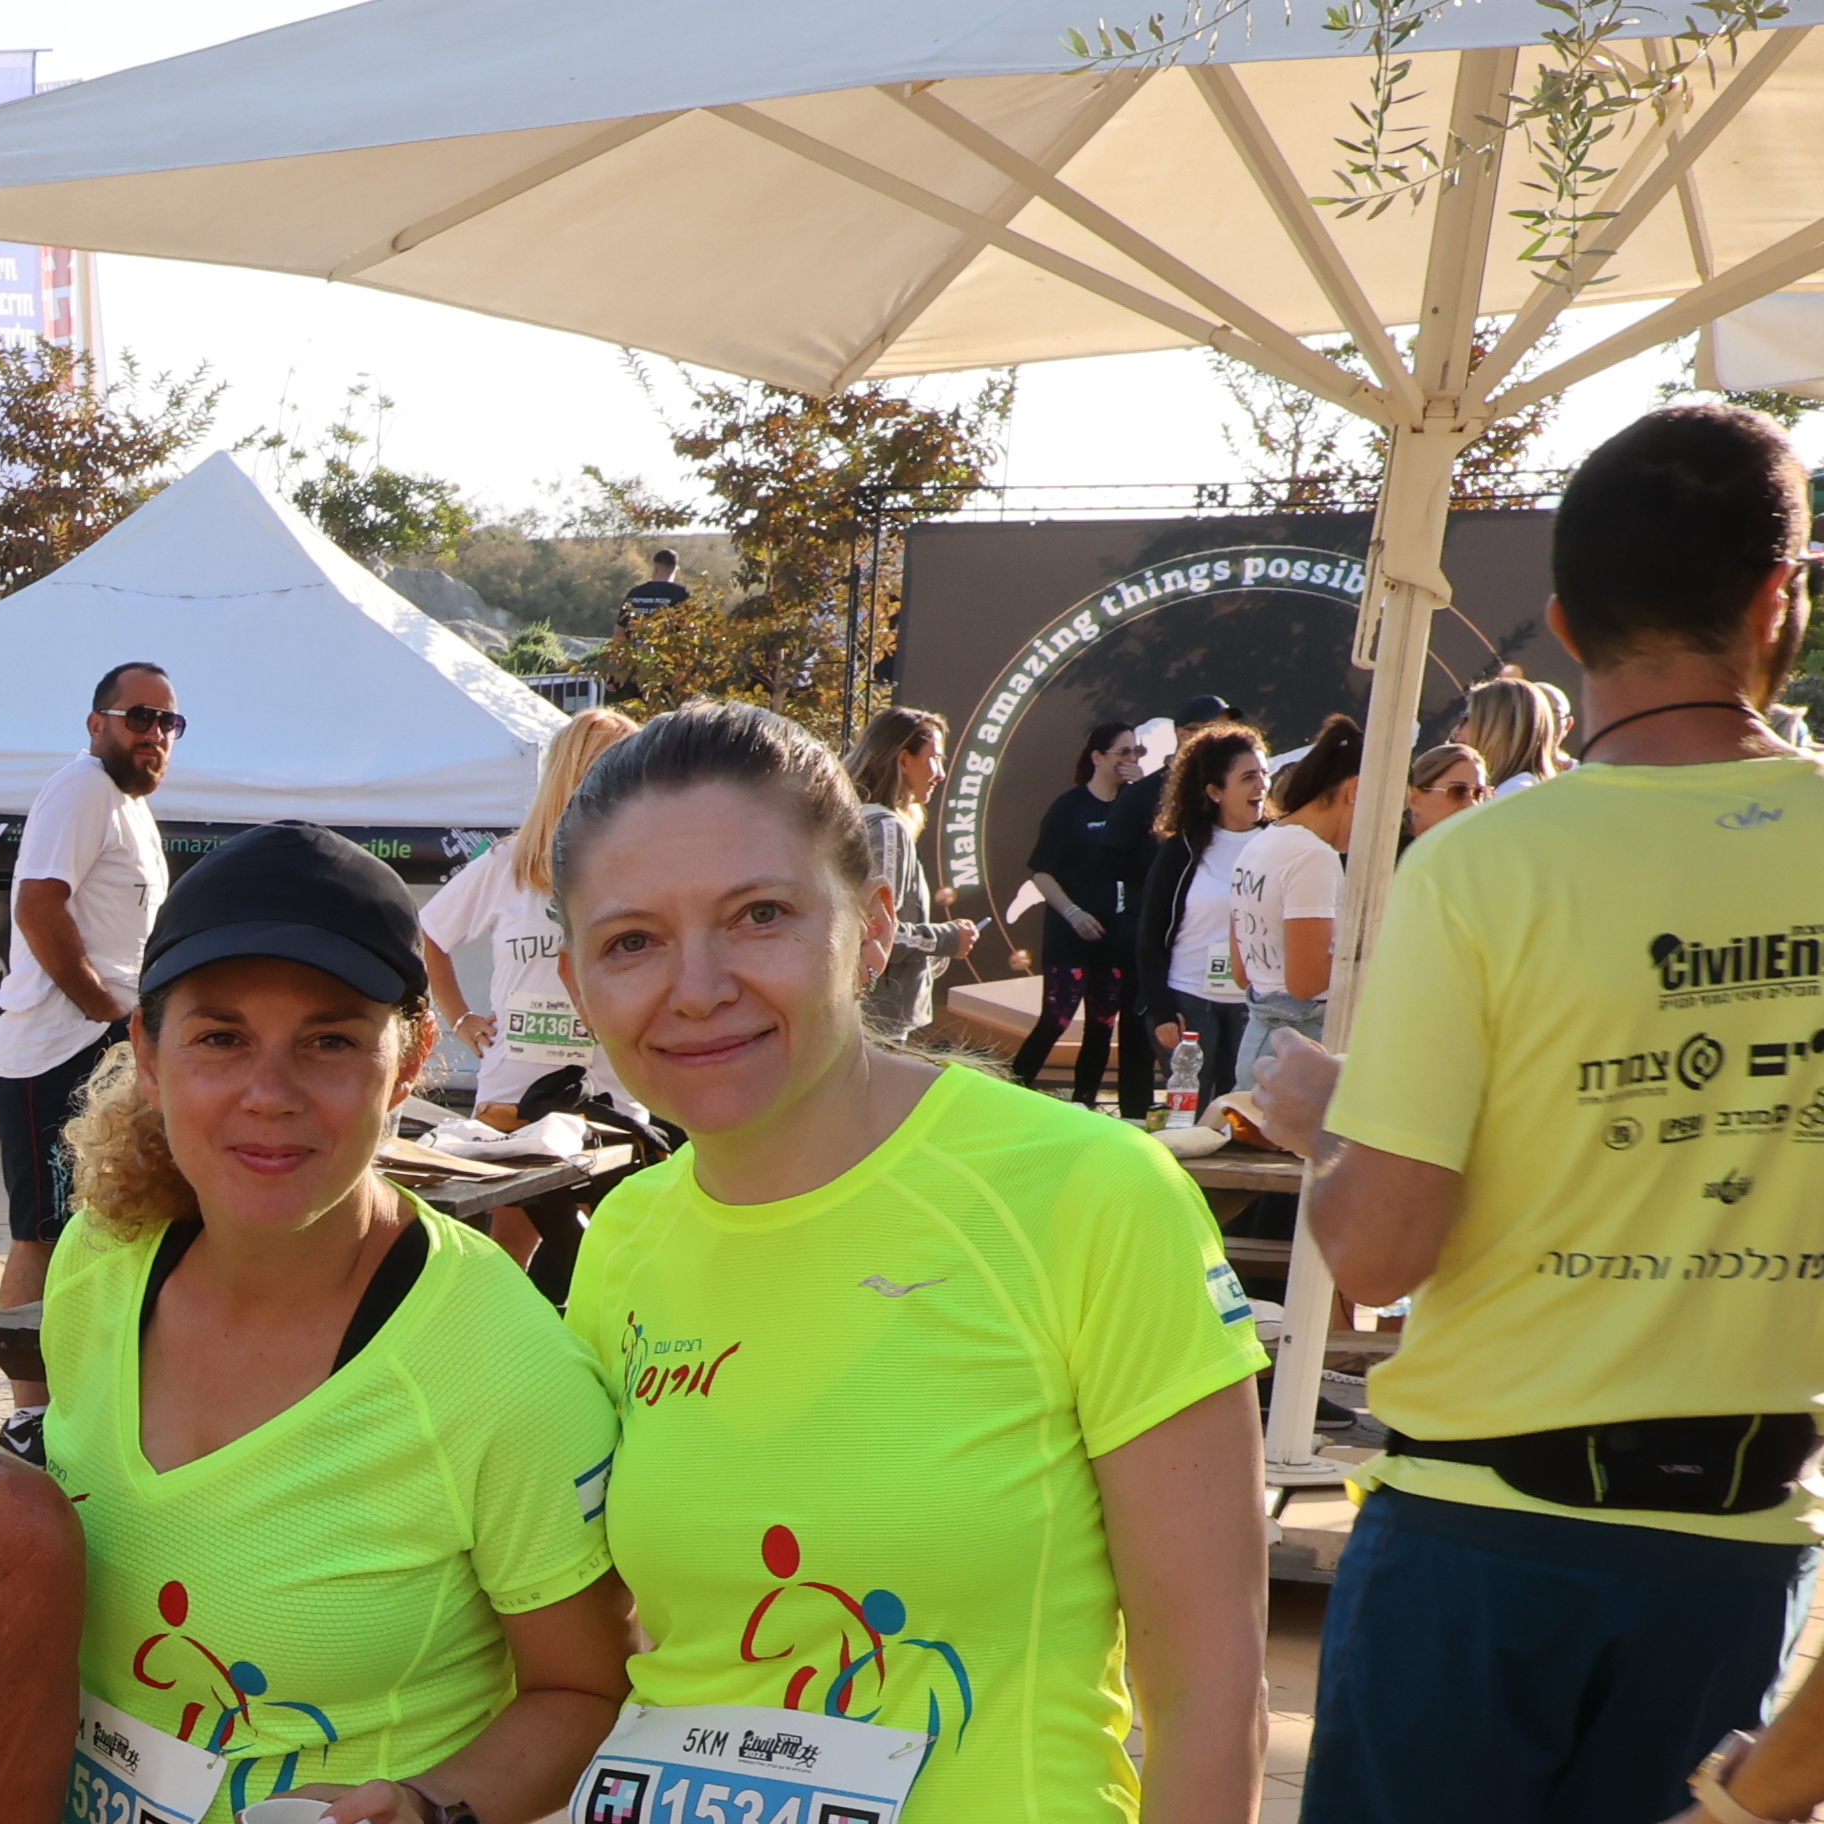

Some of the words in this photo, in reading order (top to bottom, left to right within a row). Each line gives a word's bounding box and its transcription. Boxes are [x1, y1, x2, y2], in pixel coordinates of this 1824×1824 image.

[946, 751, 995, 890] Making
[977, 609, 1100, 744] amazing
[1101, 557, 1231, 617] things
[1242, 556, 1368, 596] possib
[162, 833, 224, 856] amazi
[1655, 932, 1824, 991] CivilEn
[526, 1015, 570, 1038] 2136
[1578, 1050, 1671, 1092] צמרת
[1537, 1250, 1672, 1281] והנדסה
[653, 1338, 673, 1354] עם
[674, 1336, 703, 1354] רצים
[635, 1340, 742, 1406] לורנס
[682, 1727, 729, 1758] 5KM
[742, 1748, 770, 1761] 2022
